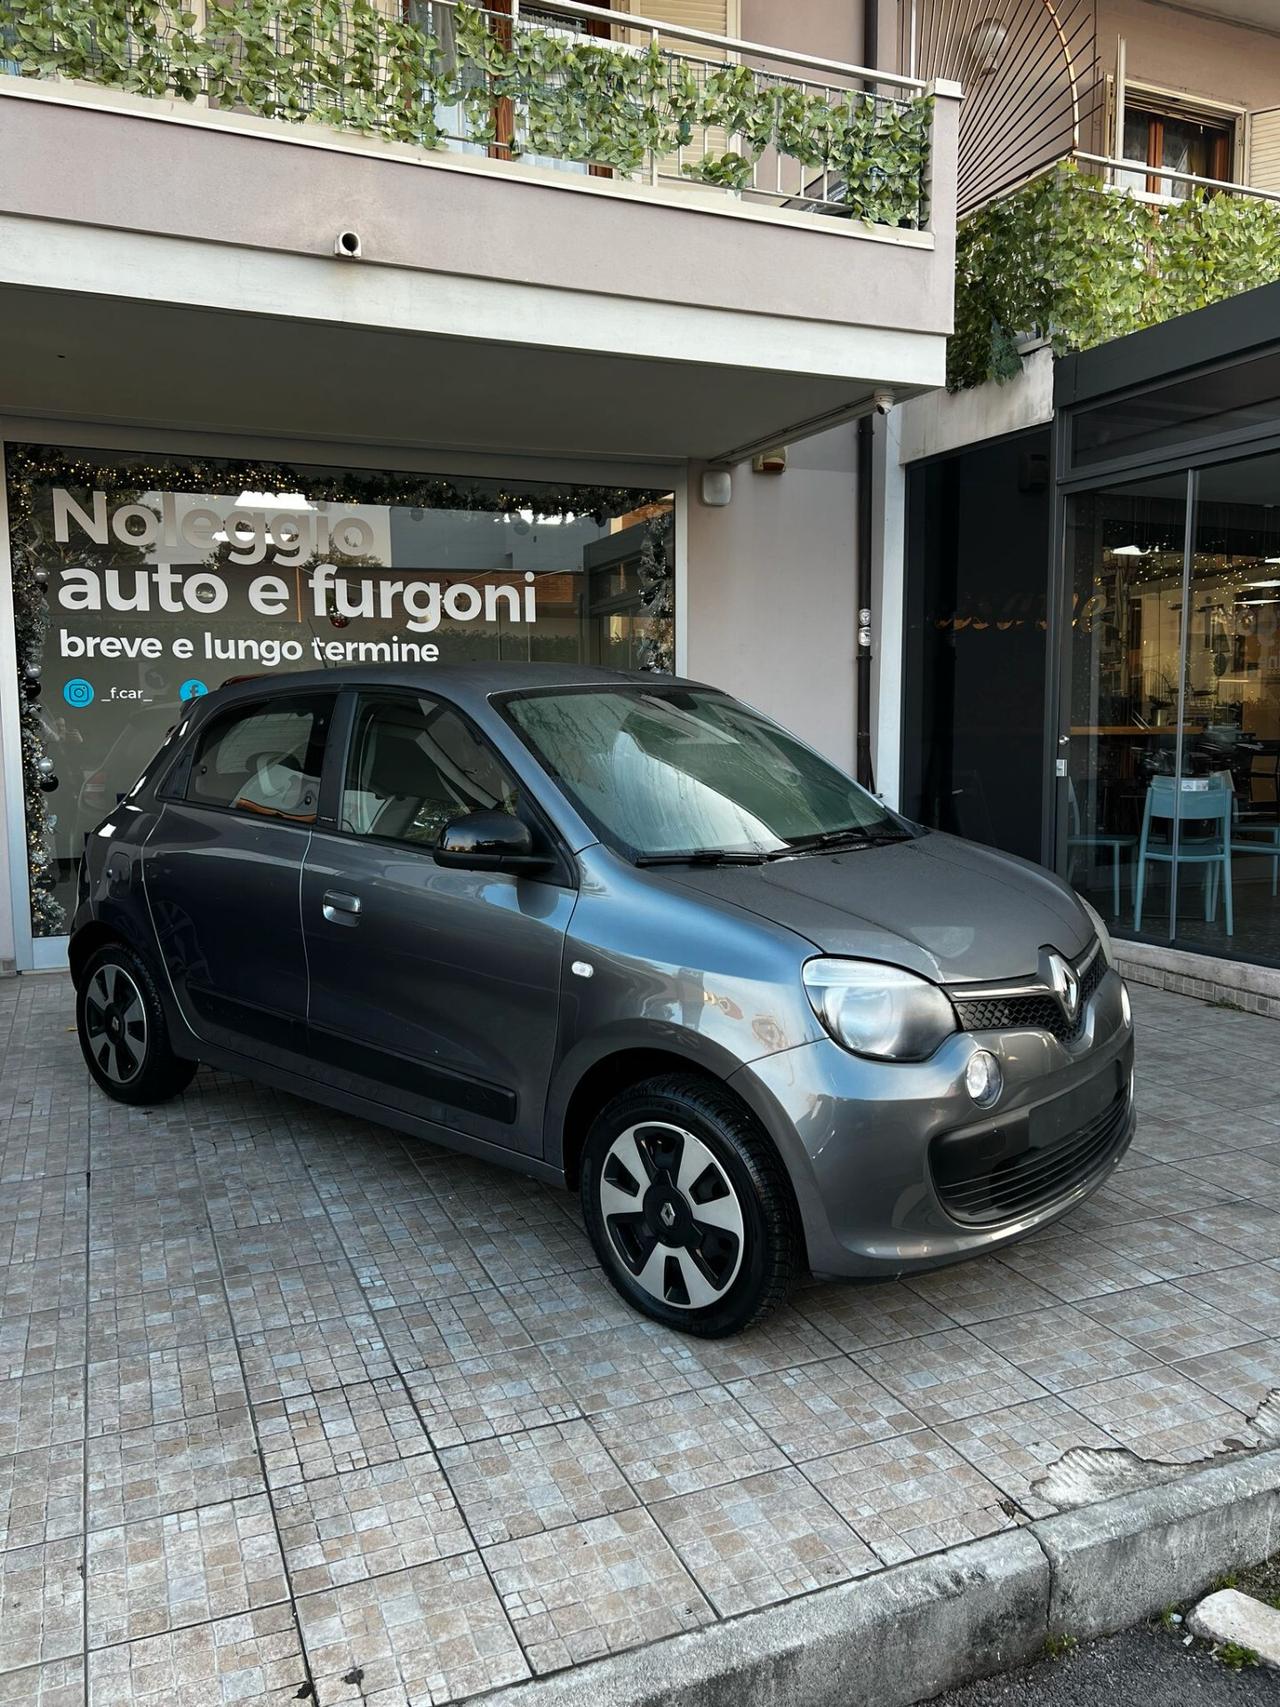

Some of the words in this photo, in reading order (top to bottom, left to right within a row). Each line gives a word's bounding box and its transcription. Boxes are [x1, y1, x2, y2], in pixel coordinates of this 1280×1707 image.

[52, 488, 374, 567] Noleggio
[58, 563, 228, 613] auto
[248, 575, 290, 615] e
[308, 563, 537, 633] furgoni
[60, 629, 162, 658] breve
[172, 637, 194, 658] e
[204, 632, 303, 666] lungo
[311, 635, 440, 662] termine
